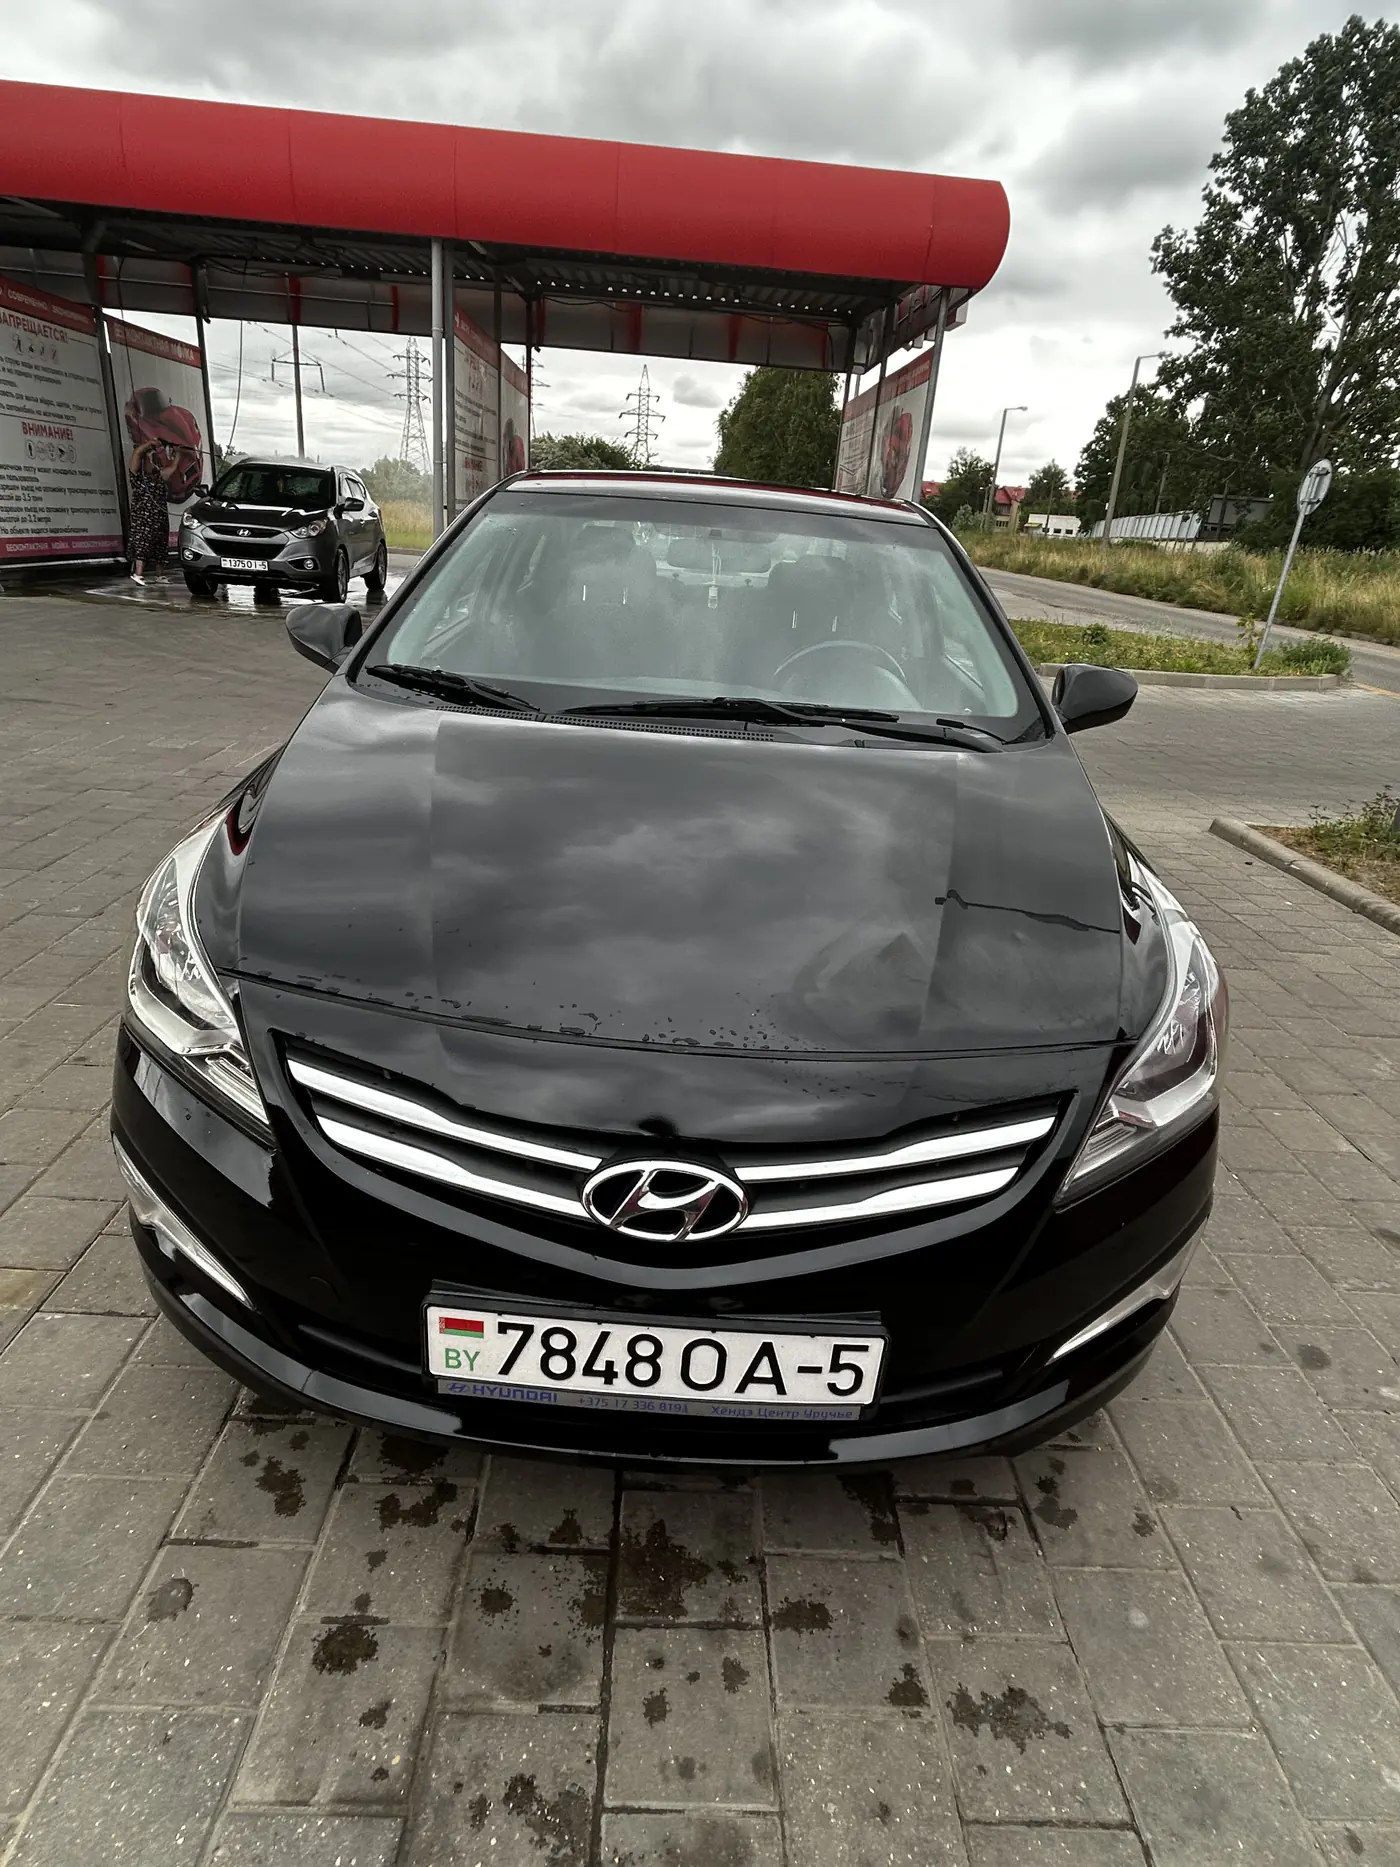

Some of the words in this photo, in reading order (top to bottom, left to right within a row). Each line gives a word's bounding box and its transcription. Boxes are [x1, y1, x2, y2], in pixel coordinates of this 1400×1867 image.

[21, 421, 74, 441] ВНИМАНИЕ!
[229, 559, 245, 568] 1375
[444, 1347, 481, 1372] BY
[497, 1321, 664, 1388] 7848
[680, 1337, 870, 1397] OA-5
[472, 1384, 558, 1403] HYUNDAI
[578, 1397, 609, 1408] +375
[614, 1399, 629, 1408] 17
[632, 1400, 655, 1411] 336
[711, 1405, 753, 1418] Хендэ
[758, 1407, 799, 1420] Центр
[803, 1410, 853, 1421] Уручье
